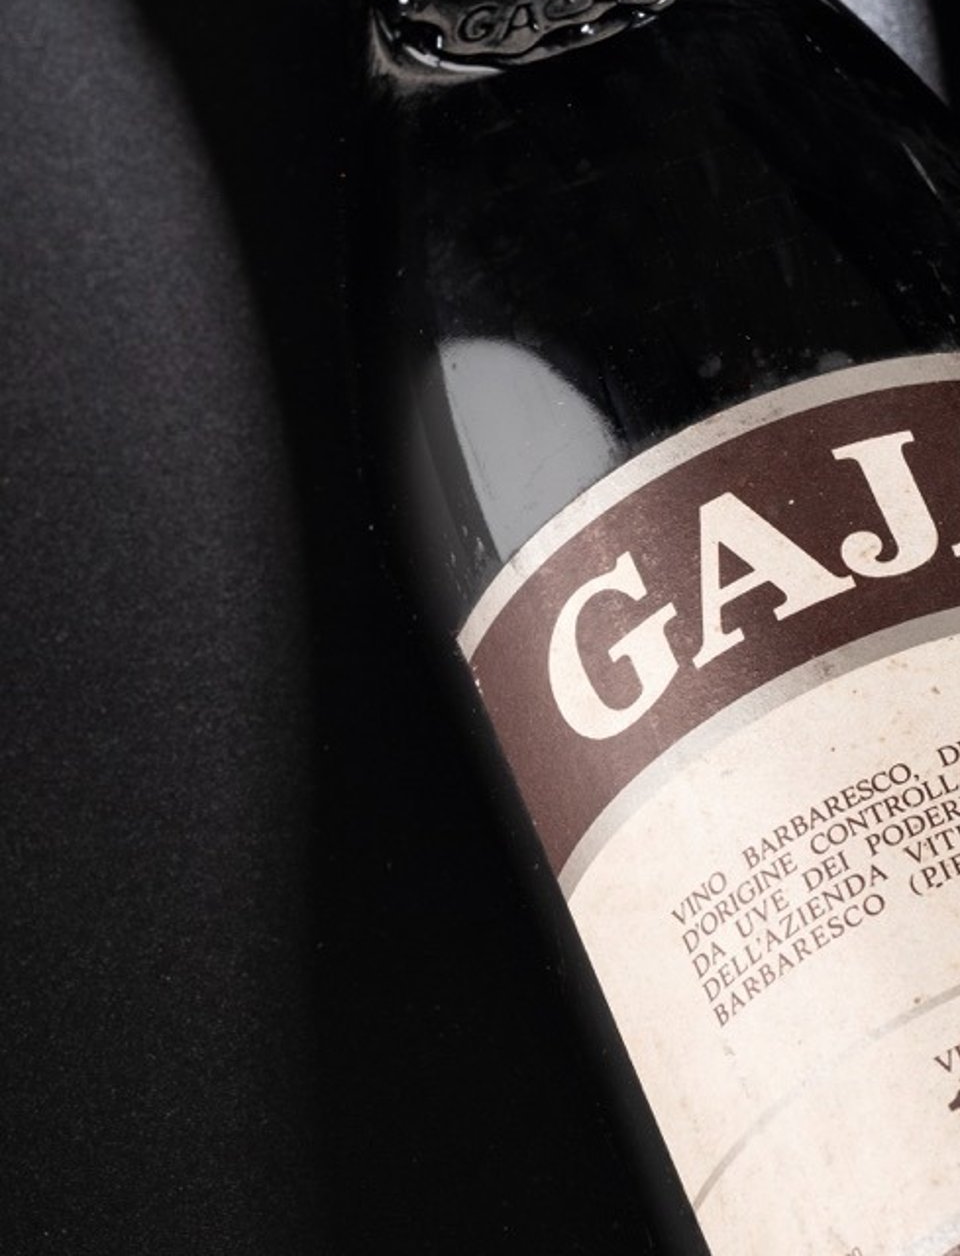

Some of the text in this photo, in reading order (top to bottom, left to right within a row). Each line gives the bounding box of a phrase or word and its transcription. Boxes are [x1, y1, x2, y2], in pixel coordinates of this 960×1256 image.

[670, 870, 727, 927] VINO
[740, 762, 921, 871] BARBARESCO,
[681, 851, 798, 955] D'ORIGINE
[691, 940, 727, 980] DA
[734, 888, 791, 939] UVE
[801, 849, 852, 893] DEI
[702, 863, 889, 1004] DELL'AZIENDA
[712, 893, 886, 1028] BARBARESCO
